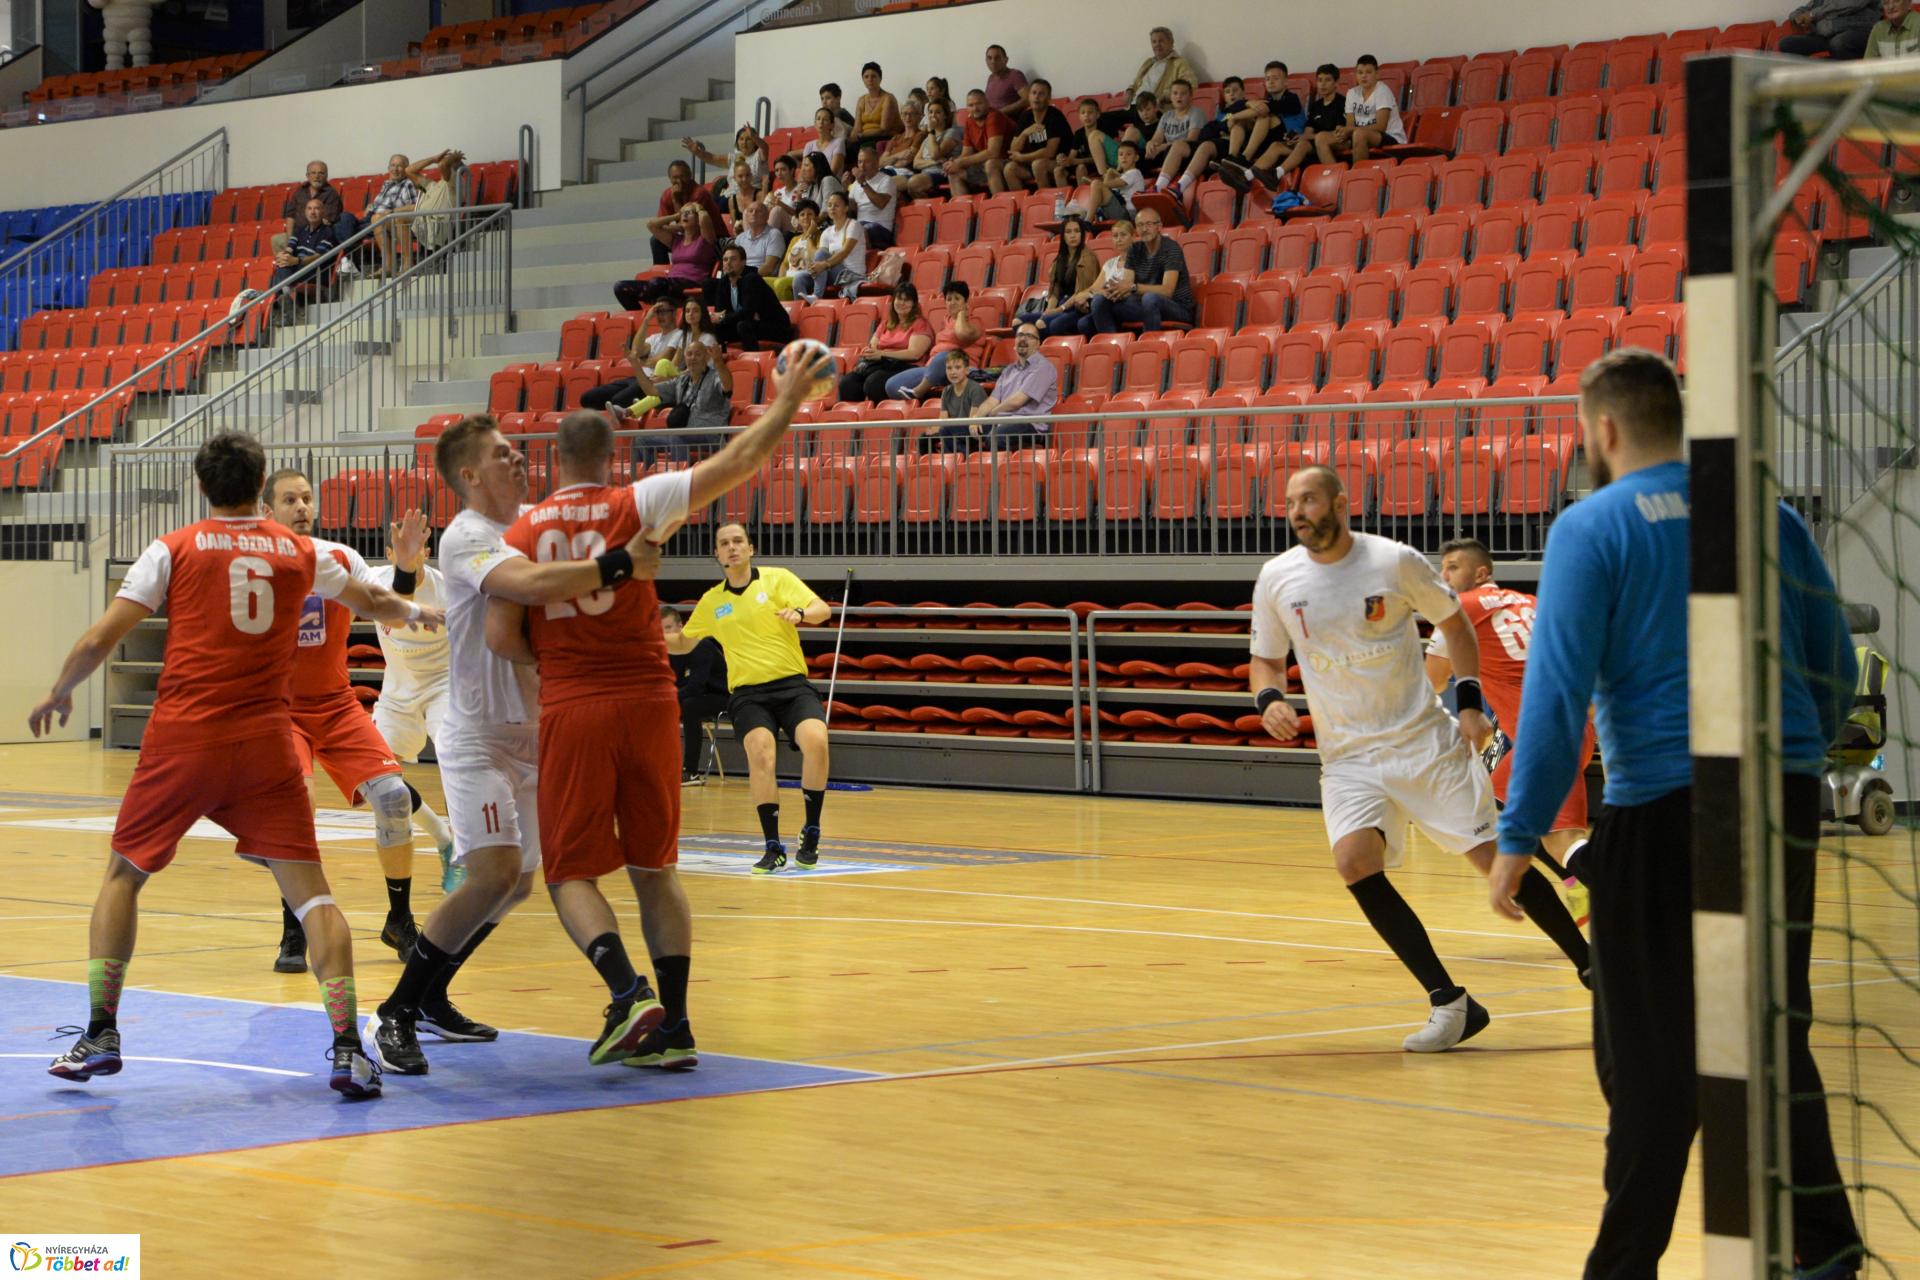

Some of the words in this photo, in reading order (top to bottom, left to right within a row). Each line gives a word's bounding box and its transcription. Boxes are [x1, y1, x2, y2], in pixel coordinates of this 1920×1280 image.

[761, 5, 814, 24] Continental
[229, 556, 275, 634] 6
[299, 631, 321, 642] AM
[481, 801, 500, 834] 11
